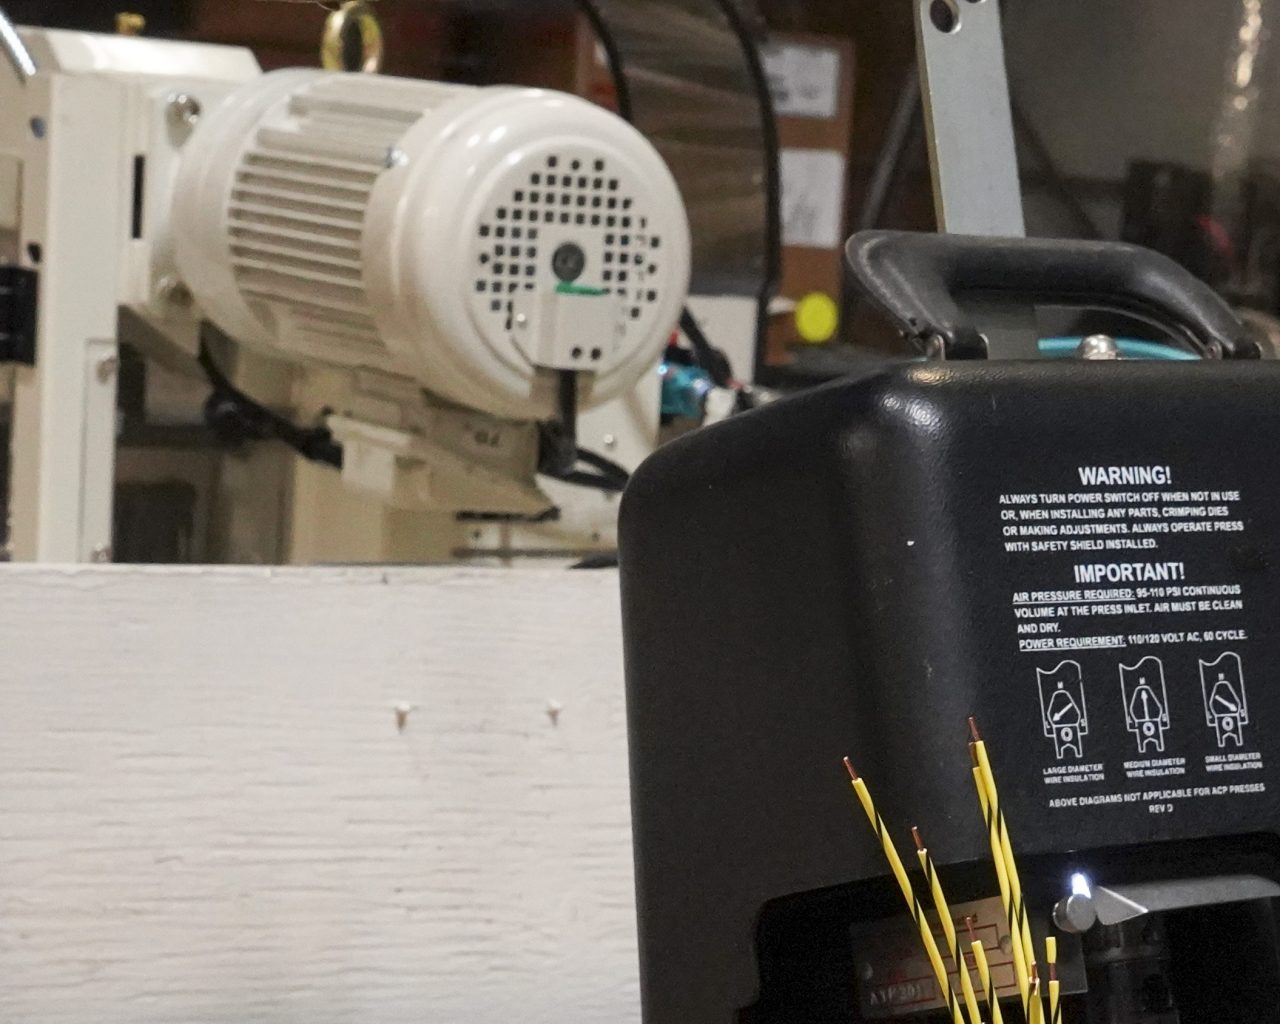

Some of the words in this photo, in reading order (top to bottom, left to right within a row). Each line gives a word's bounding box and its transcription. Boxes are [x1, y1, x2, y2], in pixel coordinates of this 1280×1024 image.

[1078, 466, 1171, 485] WARNING!
[998, 494, 1038, 503] ALWAYS
[1038, 494, 1066, 503] TURN
[1066, 493, 1103, 503] POWER
[1103, 493, 1141, 502] SWITCH
[1140, 492, 1160, 502] OFF
[1160, 492, 1189, 501] WHEN
[1189, 492, 1210, 501] NOT
[1210, 492, 1221, 501] IN
[1220, 491, 1240, 501] USE
[1000, 510, 1017, 520] OR,
[1019, 509, 1049, 520] WHEN
[1050, 508, 1105, 519] INSTALLING
[1106, 508, 1126, 518] ANY
[1127, 507, 1160, 518] PARTS,
[1161, 507, 1206, 517] CRIMPING
[1207, 506, 1228, 517] DIES
[1002, 526, 1017, 536] OR
[1019, 525, 1057, 535] MAKING
[1059, 523, 1130, 534] ADJUSTMENTS.
[1131, 523, 1169, 533] ALWAYS
[1170, 522, 1212, 532] OPERATE
[1213, 521, 1243, 531] PRESS
[1004, 541, 1029, 551] WITH
[1030, 541, 1068, 551] SAFETY
[1069, 540, 1104, 550] SHIELD
[1105, 539, 1158, 549] INSTALLED.
[1073, 562, 1185, 582] IMPORTANT!
[1012, 592, 1029, 602] AIR
[1030, 590, 1082, 601] PRESSURE
[1083, 588, 1134, 599] REQUIRED:
[1165, 587, 1181, 597] PSI
[1182, 585, 1241, 596] CONTINUOUS
[1014, 607, 1054, 618] VOLUME
[1056, 606, 1068, 616] AT
[1071, 605, 1089, 616] THE
[1091, 604, 1122, 615] PRESS
[1123, 603, 1151, 614] INLET.
[1153, 603, 1170, 613] AIR
[1170, 602, 1196, 612] MUST
[1198, 601, 1210, 611] BE
[1211, 600, 1243, 611] CLEAN
[1017, 623, 1037, 633] AND
[1039, 623, 1061, 633] DRY.
[1018, 638, 1055, 649] POWER
[1055, 635, 1126, 648] REQUIREMENT:
[1160, 633, 1185, 643] VOLT
[1185, 632, 1202, 642] AC,
[1214, 630, 1247, 641] CYCLE.
[1049, 798, 1077, 808] ABOVE
[1079, 795, 1122, 805] DIAGRAMS
[1123, 793, 1140, 802] NOT
[1142, 789, 1191, 800] APPLICABLE
[1193, 788, 1210, 796] FOR
[1211, 786, 1228, 795] ACP
[1229, 783, 1265, 793] PRESSES
